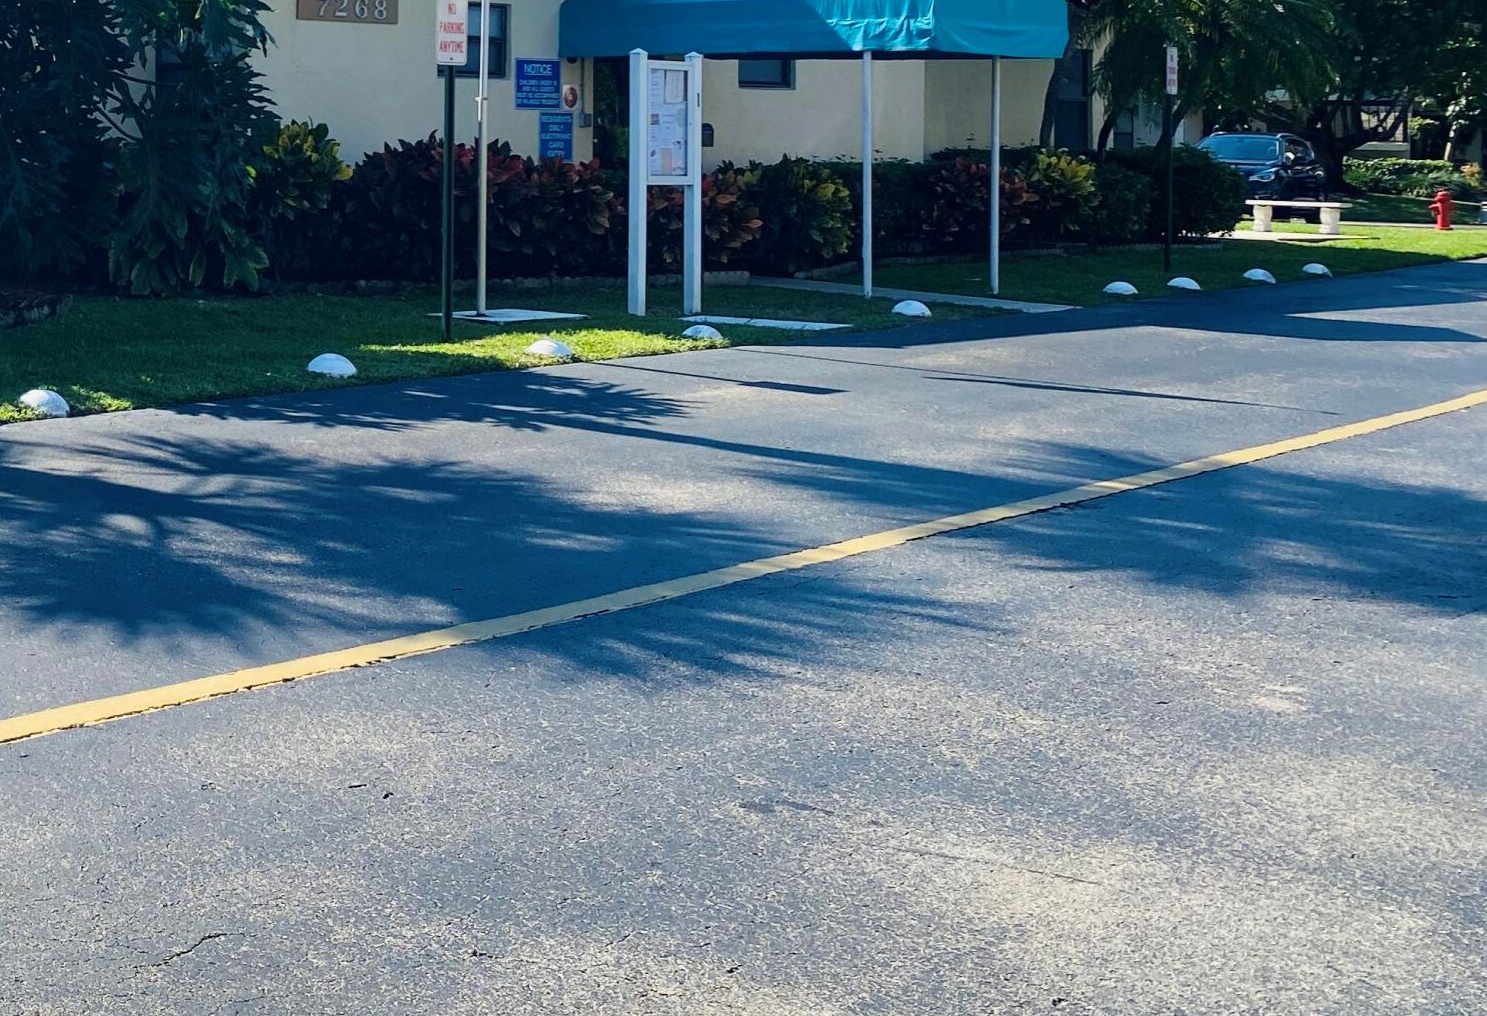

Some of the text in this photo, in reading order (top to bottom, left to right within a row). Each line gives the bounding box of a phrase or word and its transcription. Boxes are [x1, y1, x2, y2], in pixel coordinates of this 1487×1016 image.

[447, 3, 456, 15] NO
[439, 22, 464, 34] PARKING
[439, 40, 464, 53] ANYTIME
[524, 64, 552, 74] NOTICE
